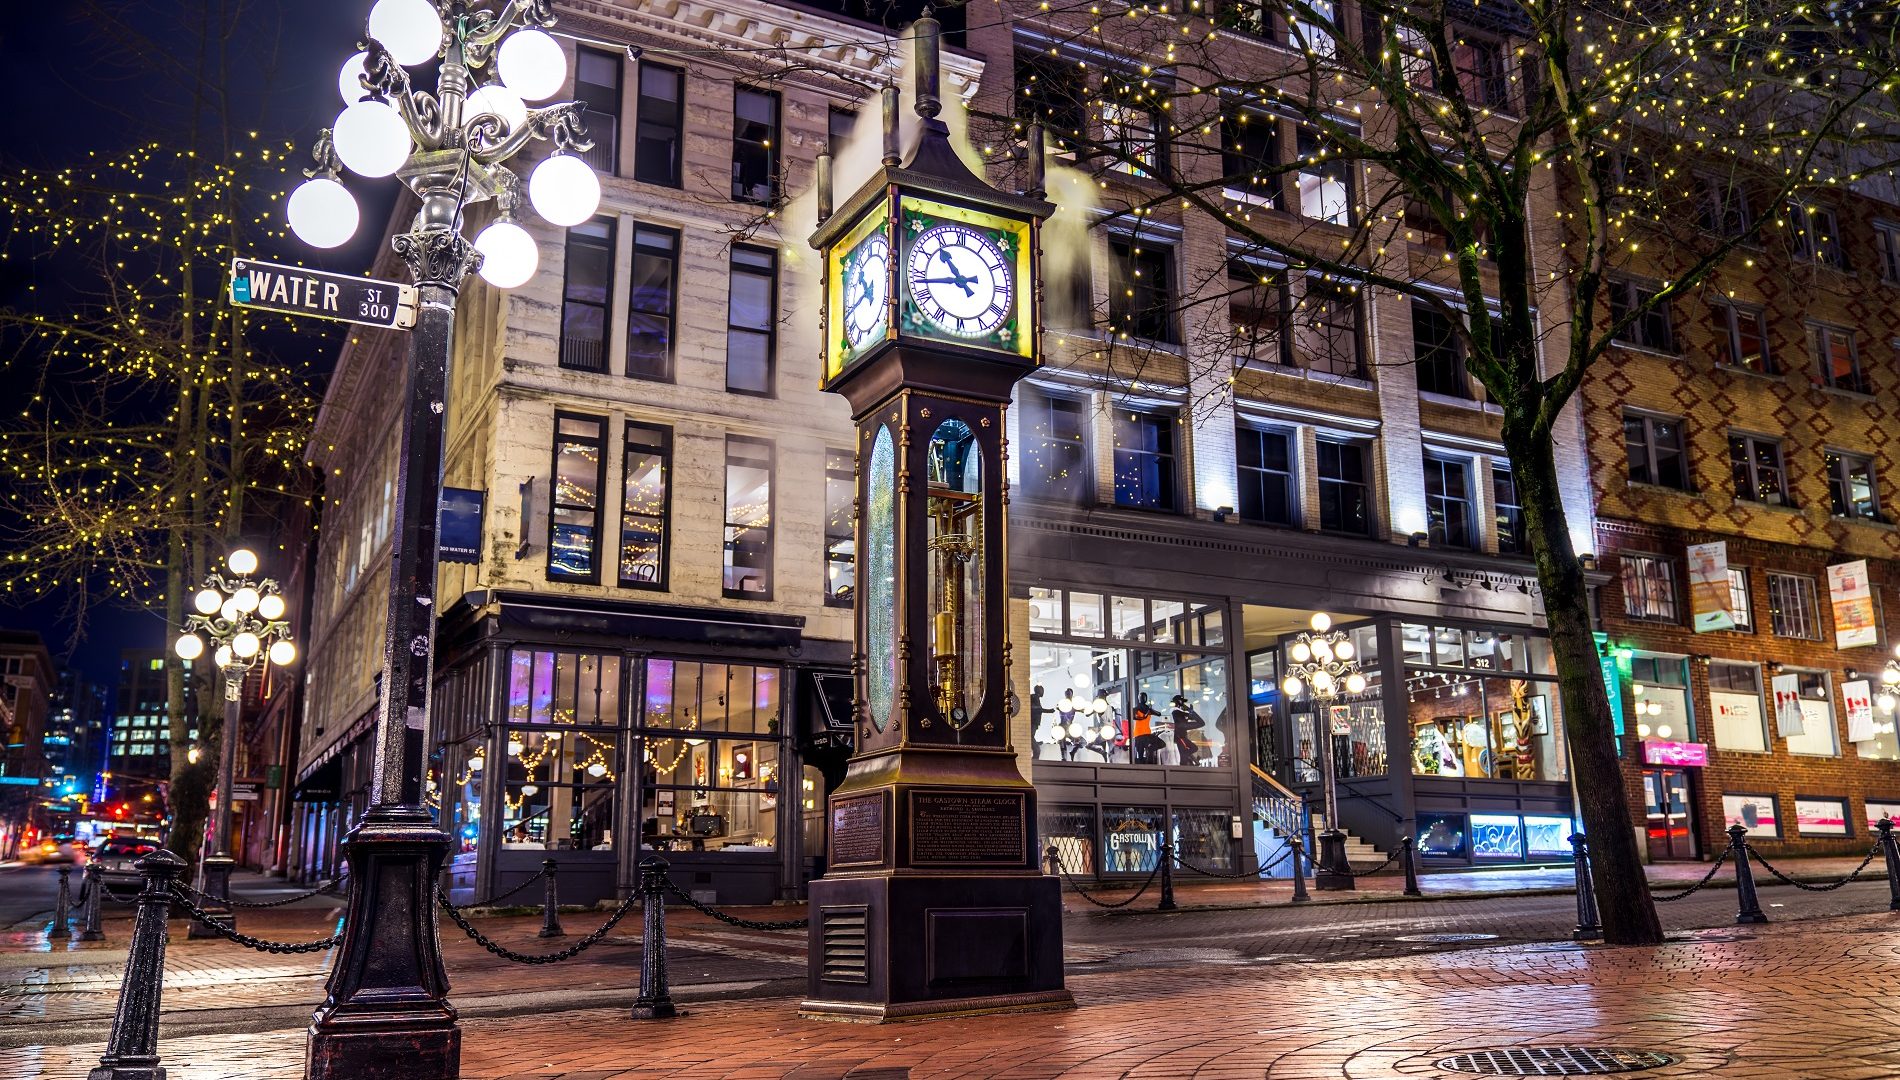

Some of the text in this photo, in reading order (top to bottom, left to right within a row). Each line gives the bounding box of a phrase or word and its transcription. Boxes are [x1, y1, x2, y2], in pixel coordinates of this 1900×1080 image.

[249, 269, 383, 312] WATER ST
[360, 303, 389, 319] 300
[1475, 658, 1489, 668] 312
[919, 796, 1016, 805] THE GASTOWN STEAM CLOCK
[1110, 832, 1157, 851] GASTOWN
